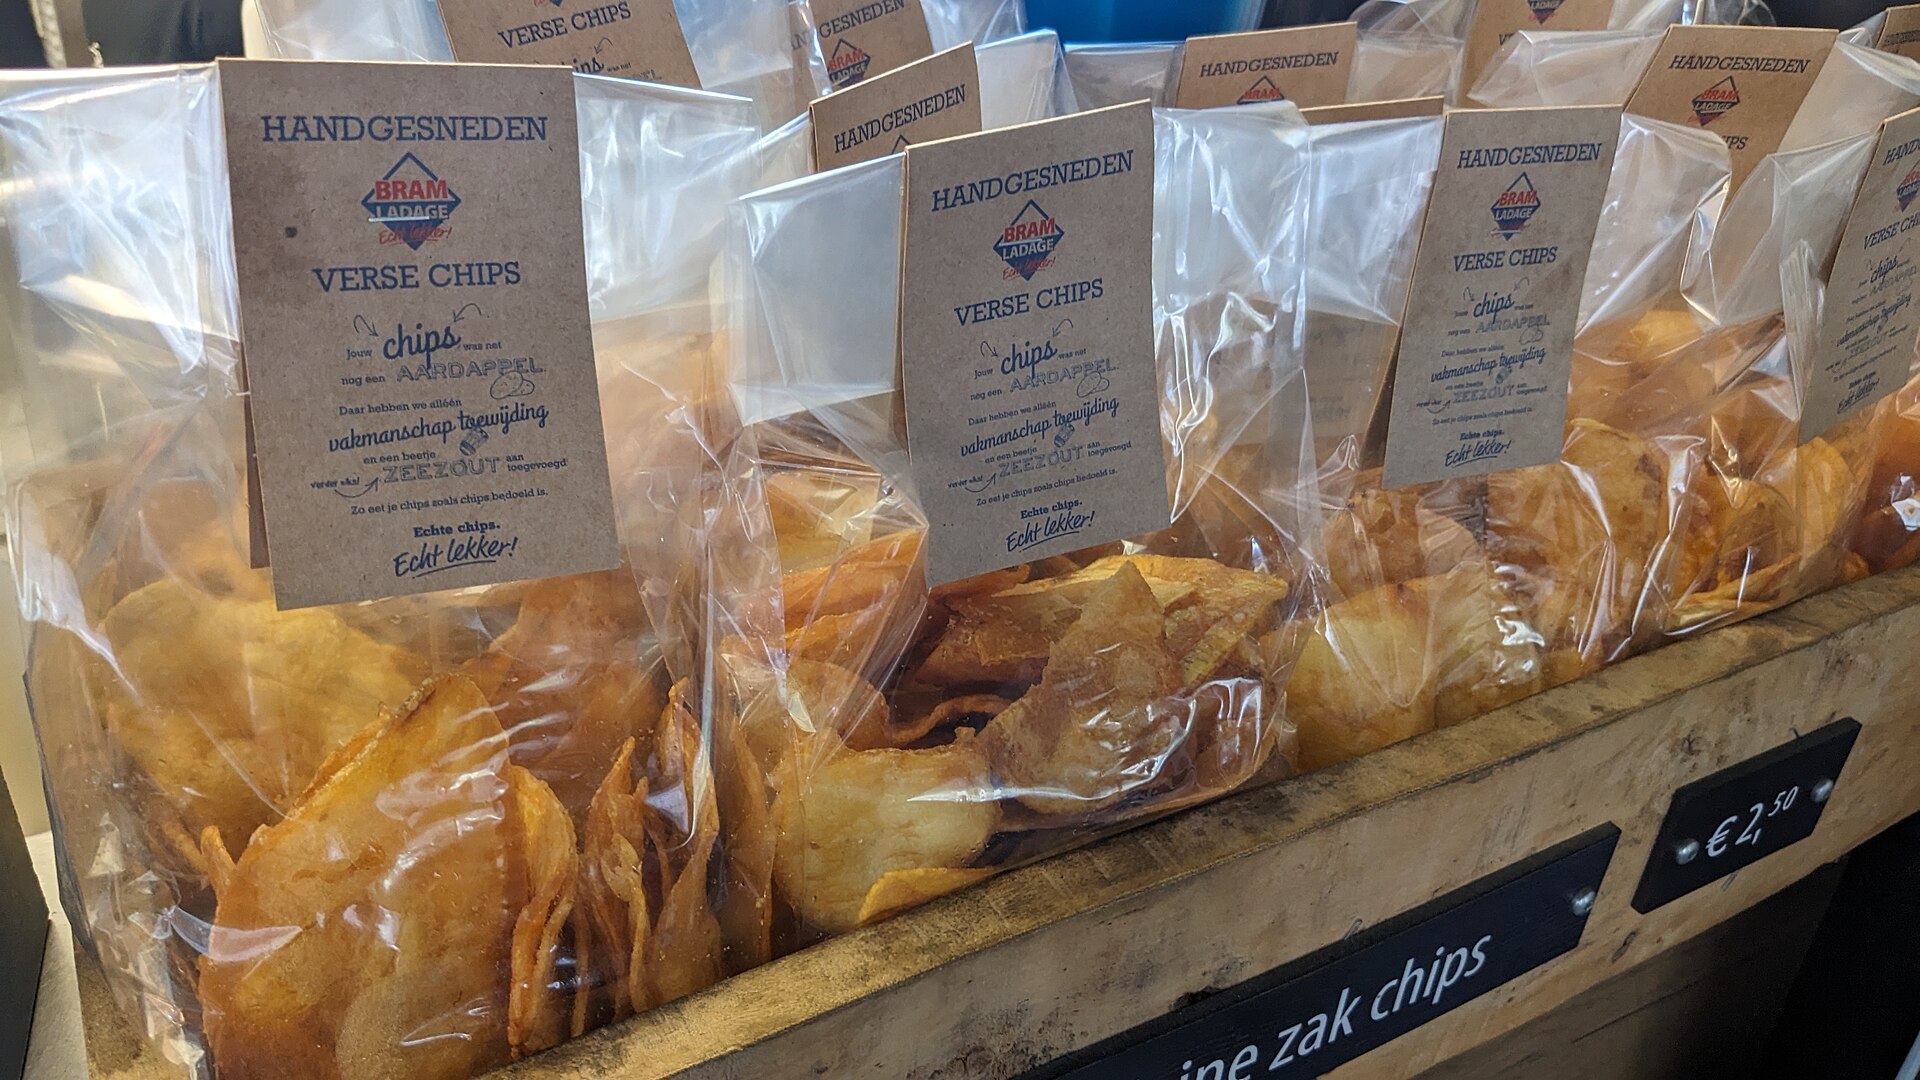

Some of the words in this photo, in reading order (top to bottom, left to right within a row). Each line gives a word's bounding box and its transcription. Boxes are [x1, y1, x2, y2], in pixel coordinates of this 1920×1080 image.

[498, 17, 568, 49] VERSE
[571, 1, 632, 31] CHIPS
[828, 48, 865, 73] BRAM
[1200, 52, 1339, 77] HANDGESNEDEN
[1668, 55, 1811, 73] HANDGESNEDEN
[1700, 88, 1740, 101] BRAM
[262, 116, 548, 142] HANDGESNEDEN
[835, 84, 966, 154] HANDGESNEDEN
[1457, 143, 1602, 169] HANDGESNEDEN
[1722, 135, 1749, 150] IPS
[375, 180, 449, 200] BRAM
[931, 150, 1134, 212] HANDGESNEDEN
[1499, 190, 1537, 206] BRAM
[375, 205, 450, 220] LADAGE
[1495, 208, 1534, 221] LADAGE
[1003, 216, 1055, 244] BRAM
[1864, 221, 1900, 250] VERSE
[1002, 238, 1055, 260] LADAGE
[1454, 251, 1505, 272] VERSE
[1509, 246, 1558, 267] CHIPS
[313, 265, 420, 292] VERSE
[429, 261, 521, 288] CHIPS
[954, 294, 1029, 326] VERSE
[1036, 278, 1104, 309] CHIPS
[1473, 292, 1515, 324] chips
[346, 349, 372, 361] Jouw
[382, 323, 461, 370] chips
[463, 343, 483, 352] was
[974, 368, 994, 380] Jouw
[1000, 340, 1057, 380] chips
[341, 377, 362, 387] nog
[366, 375, 385, 384] een
[970, 391, 986, 401] nog
[987, 388, 1002, 397] een
[339, 406, 364, 416] Daar
[368, 402, 409, 414] hebben
[412, 402, 427, 411] we
[968, 417, 987, 426] Daar
[989, 409, 1019, 421] hebben
[328, 417, 456, 452] vakmanschap
[960, 419, 1051, 457] vakmanschap
[363, 456, 377, 465] en
[379, 454, 399, 464] een
[402, 450, 436, 463] beetje
[383, 456, 500, 483] ZEEZOUT
[505, 453, 524, 463] aan
[999, 446, 1083, 477] ZEEZOUT
[1445, 444, 1472, 468] Echt
[1473, 440, 1511, 459] lekker!
[351, 504, 365, 515] Zo
[368, 504, 385, 514] eet
[387, 502, 398, 514] je
[400, 500, 430, 512] chips
[432, 497, 458, 507] zoals
[460, 493, 489, 505] chips
[492, 488, 535, 502] bedoeld
[537, 486, 548, 497] is.
[976, 498, 987, 506] Zo
[1011, 488, 1033, 499] chips
[1054, 478, 1076, 488] chips
[1021, 507, 1049, 519] Echte
[1052, 500, 1083, 512] chips.
[413, 526, 453, 538] Echte
[457, 521, 500, 535] chips.
[1006, 522, 1040, 552] Echt
[1044, 511, 1095, 538] lekker!
[393, 543, 443, 578] Echt
[447, 536, 518, 563] lekker!
[1705, 815, 1738, 857] €
[1268, 987, 1362, 1071] zak
[1370, 934, 1493, 1022] chips
